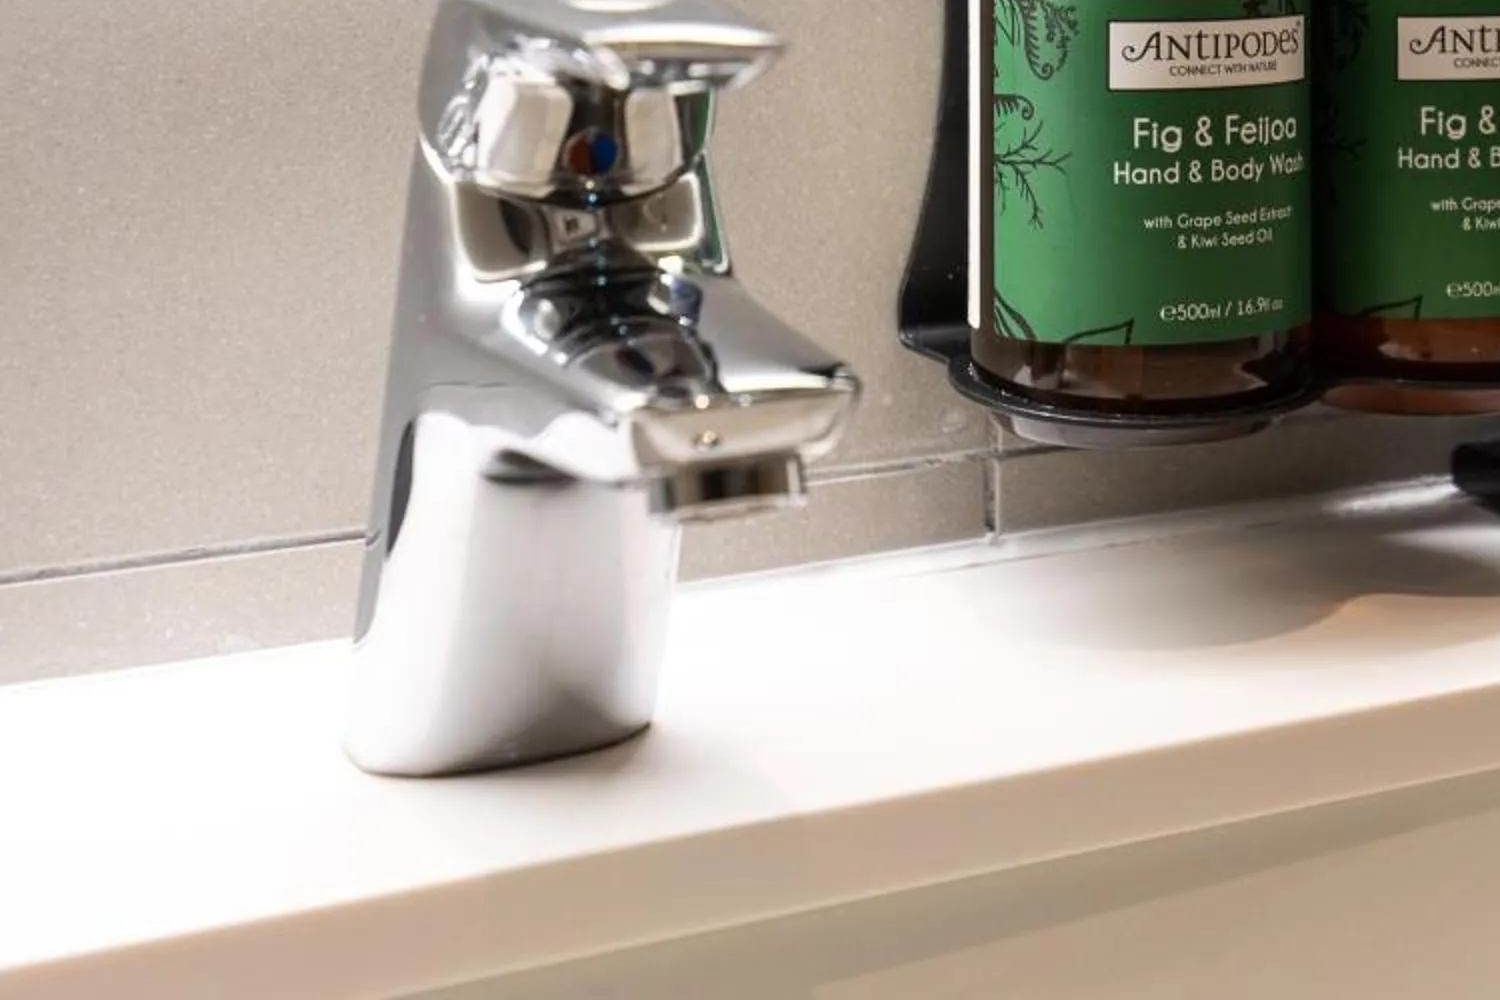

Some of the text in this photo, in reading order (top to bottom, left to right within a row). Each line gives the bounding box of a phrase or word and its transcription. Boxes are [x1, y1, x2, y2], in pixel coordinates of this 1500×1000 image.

[1169, 60, 1277, 77] CONNECT WITH NATURE
[1420, 105, 1467, 140] Fig
[1478, 104, 1496, 135] &
[1133, 113, 1297, 153] Fig & Feijoa
[1113, 151, 1304, 185] Hand & Body Wash
[1397, 147, 1460, 169] Hand
[1467, 147, 1481, 169] &
[1430, 197, 1458, 212] with
[1143, 214, 1173, 229] with
[1176, 212, 1222, 231] Grape
[1224, 210, 1257, 225] Seed
[1462, 216, 1472, 231] &
[1177, 234, 1187, 249] &
[1191, 233, 1219, 249] Kiwi
[1221, 231, 1255, 247] Seed
